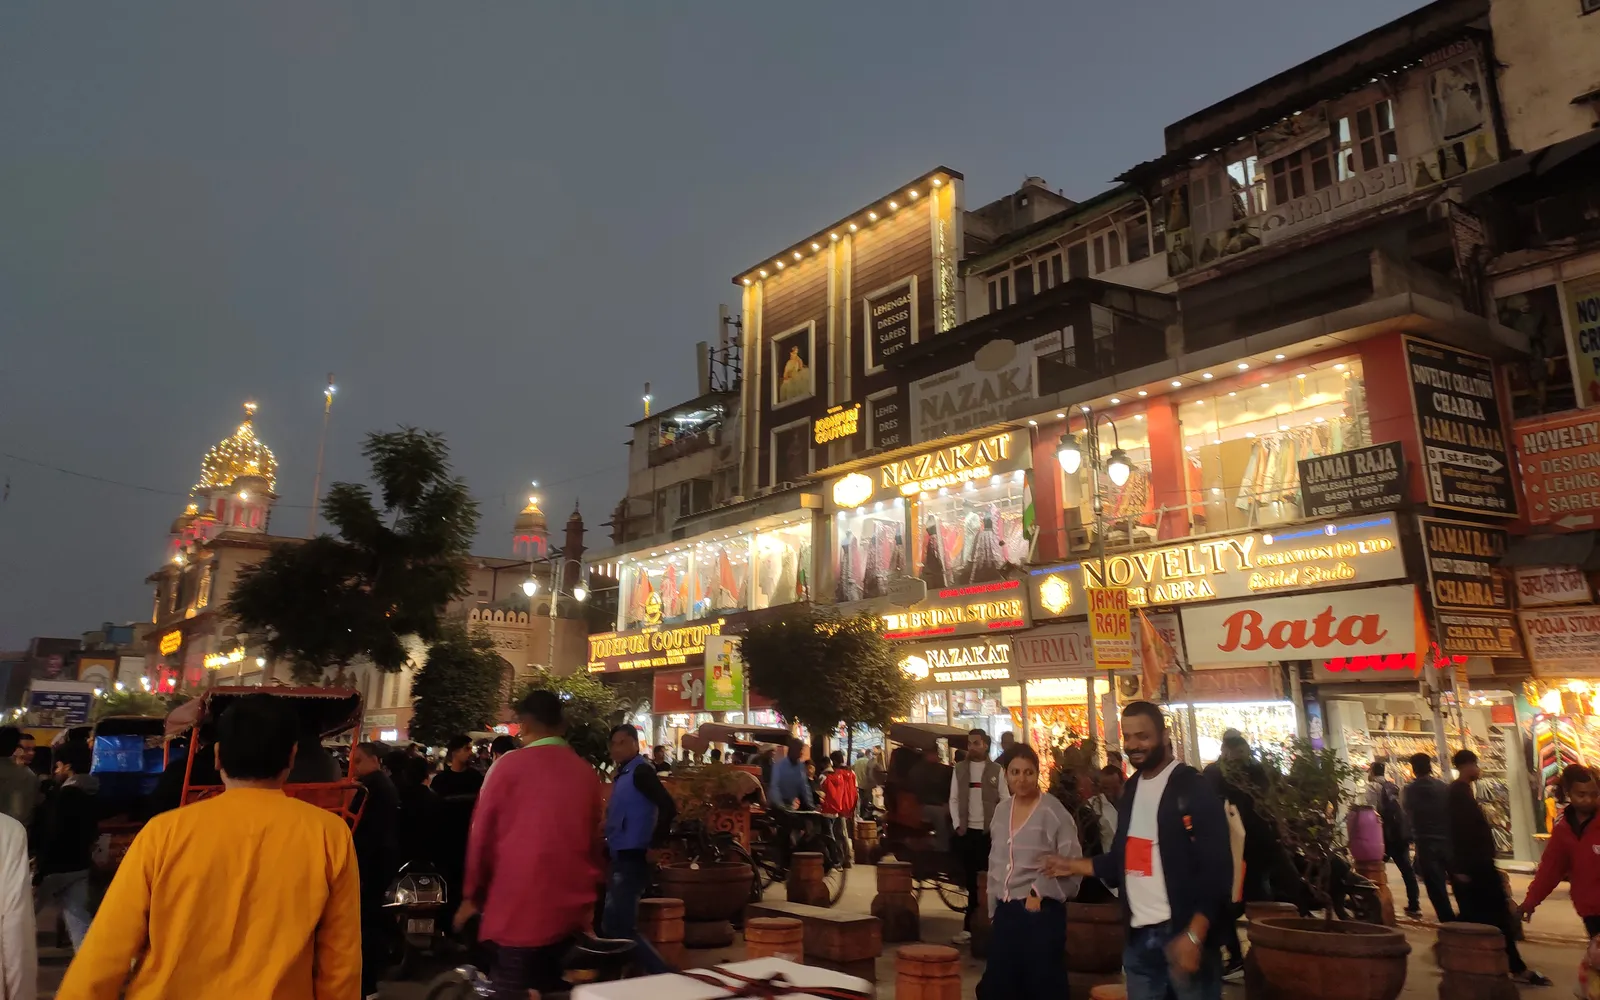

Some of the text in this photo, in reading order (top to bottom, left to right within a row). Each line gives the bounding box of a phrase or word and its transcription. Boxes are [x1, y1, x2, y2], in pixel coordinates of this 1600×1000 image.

[873, 292, 912, 317] LEHENGAS
[877, 309, 909, 330] DRESSES
[879, 326, 907, 344] SAREES
[1432, 391, 1486, 421] CHABRA
[1423, 415, 1504, 451] JAMAI RAJA
[1522, 421, 1600, 455] NOVELTY
[879, 431, 1011, 489] NAZAKAT
[1306, 447, 1397, 484] JAMAI RAJA
[1461, 454, 1495, 468] Floor
[1308, 470, 1399, 495] WHOLESALE PRICE SHOP
[1373, 493, 1402, 507] FLOOR
[1429, 525, 1473, 555] JAMAI
[1081, 535, 1256, 590] NOVELTY
[1255, 545, 1334, 568] CREATION
[1248, 561, 1357, 592] Bridal Studio
[1519, 575, 1544, 597] जय
[1090, 589, 1129, 612] JAMAI
[1435, 579, 1496, 607] CHABRA
[909, 605, 967, 629] BRIDAL
[965, 599, 1023, 623] STORE
[1095, 613, 1127, 637] RAJA
[1525, 616, 1569, 636] POOJA
[1217, 604, 1389, 652] Bata
[1447, 626, 1496, 639] CHABRA
[925, 643, 1010, 669] NAZAKAT
[1019, 635, 1080, 664] VERMA
[1444, 637, 1477, 651] JAMAI
[933, 668, 1010, 683] THE BRIDAL STORE
